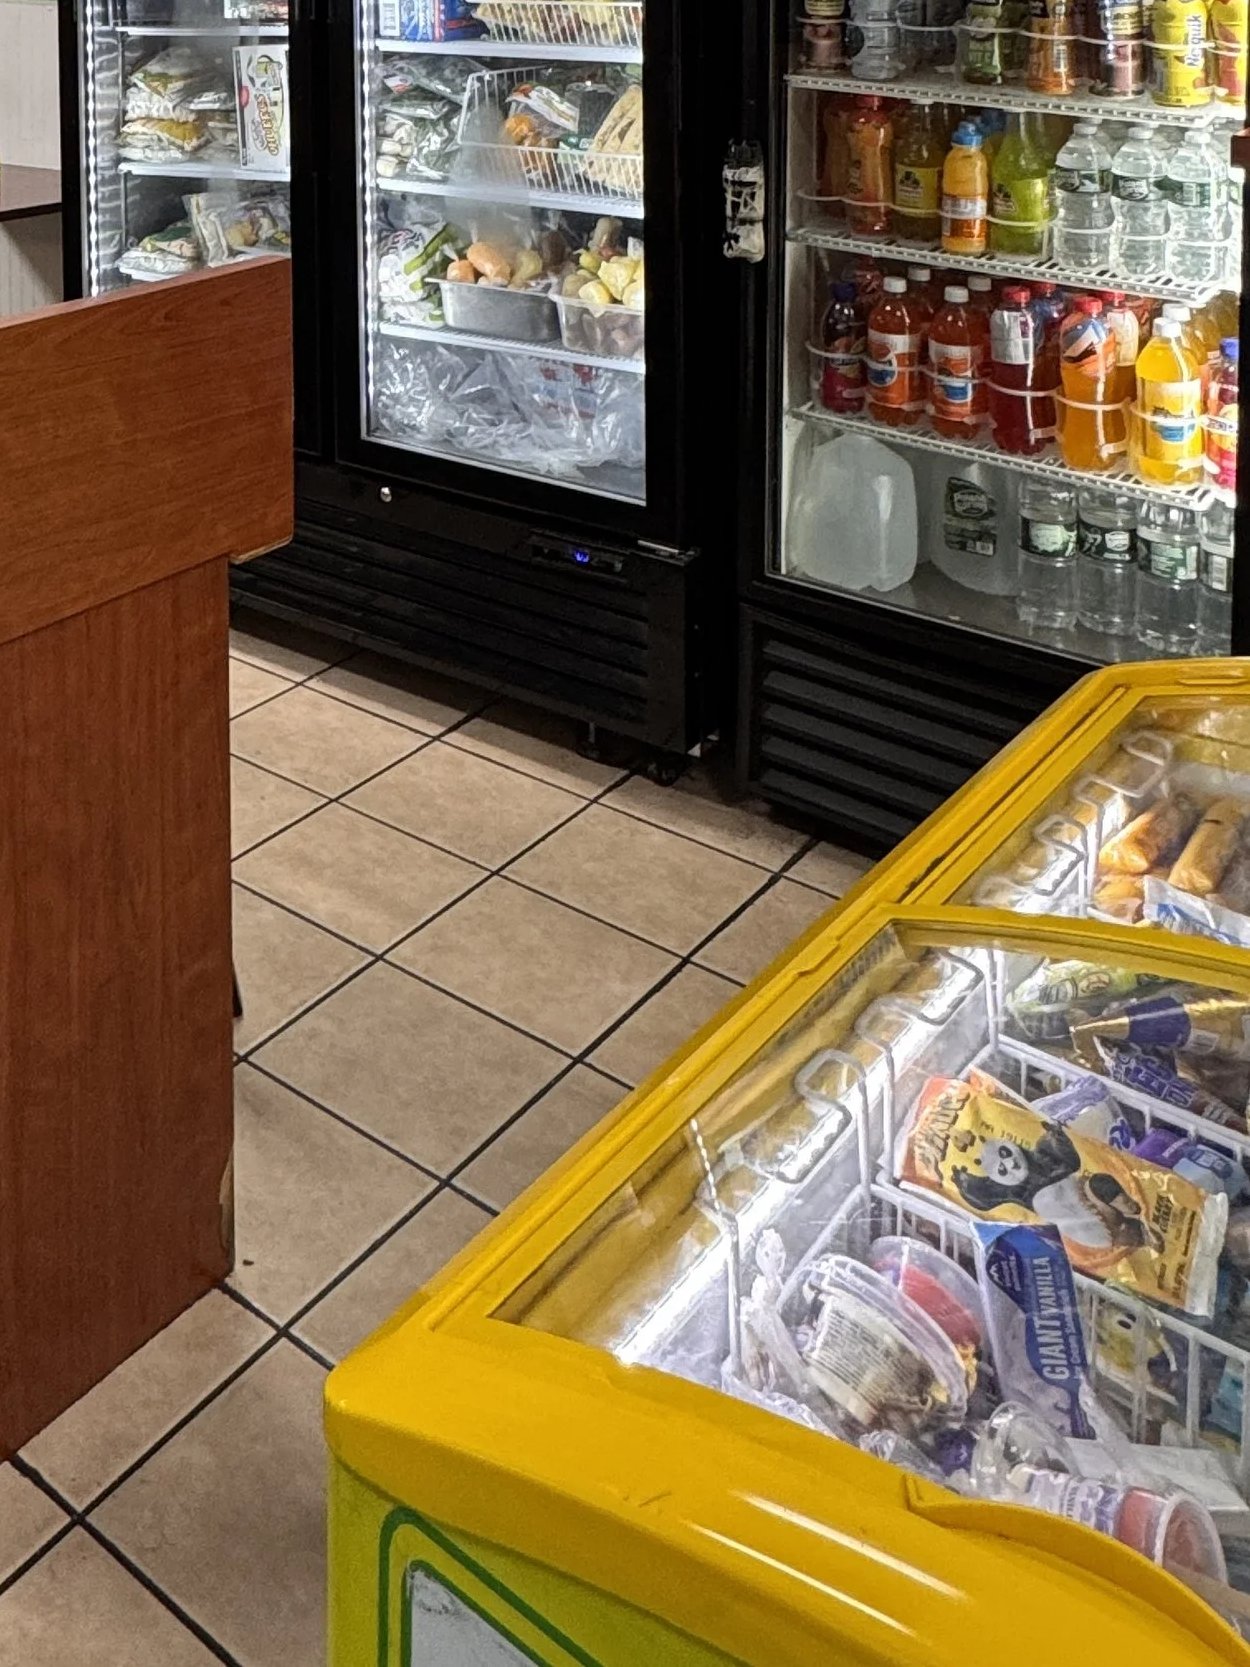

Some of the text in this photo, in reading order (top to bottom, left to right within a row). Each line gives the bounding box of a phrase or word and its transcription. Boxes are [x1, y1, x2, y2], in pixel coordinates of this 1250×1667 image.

[1185, 14, 1202, 67] Nequik
[1033, 1256, 1061, 1316] VANILLA
[1034, 1313, 1070, 1381] GIANT
